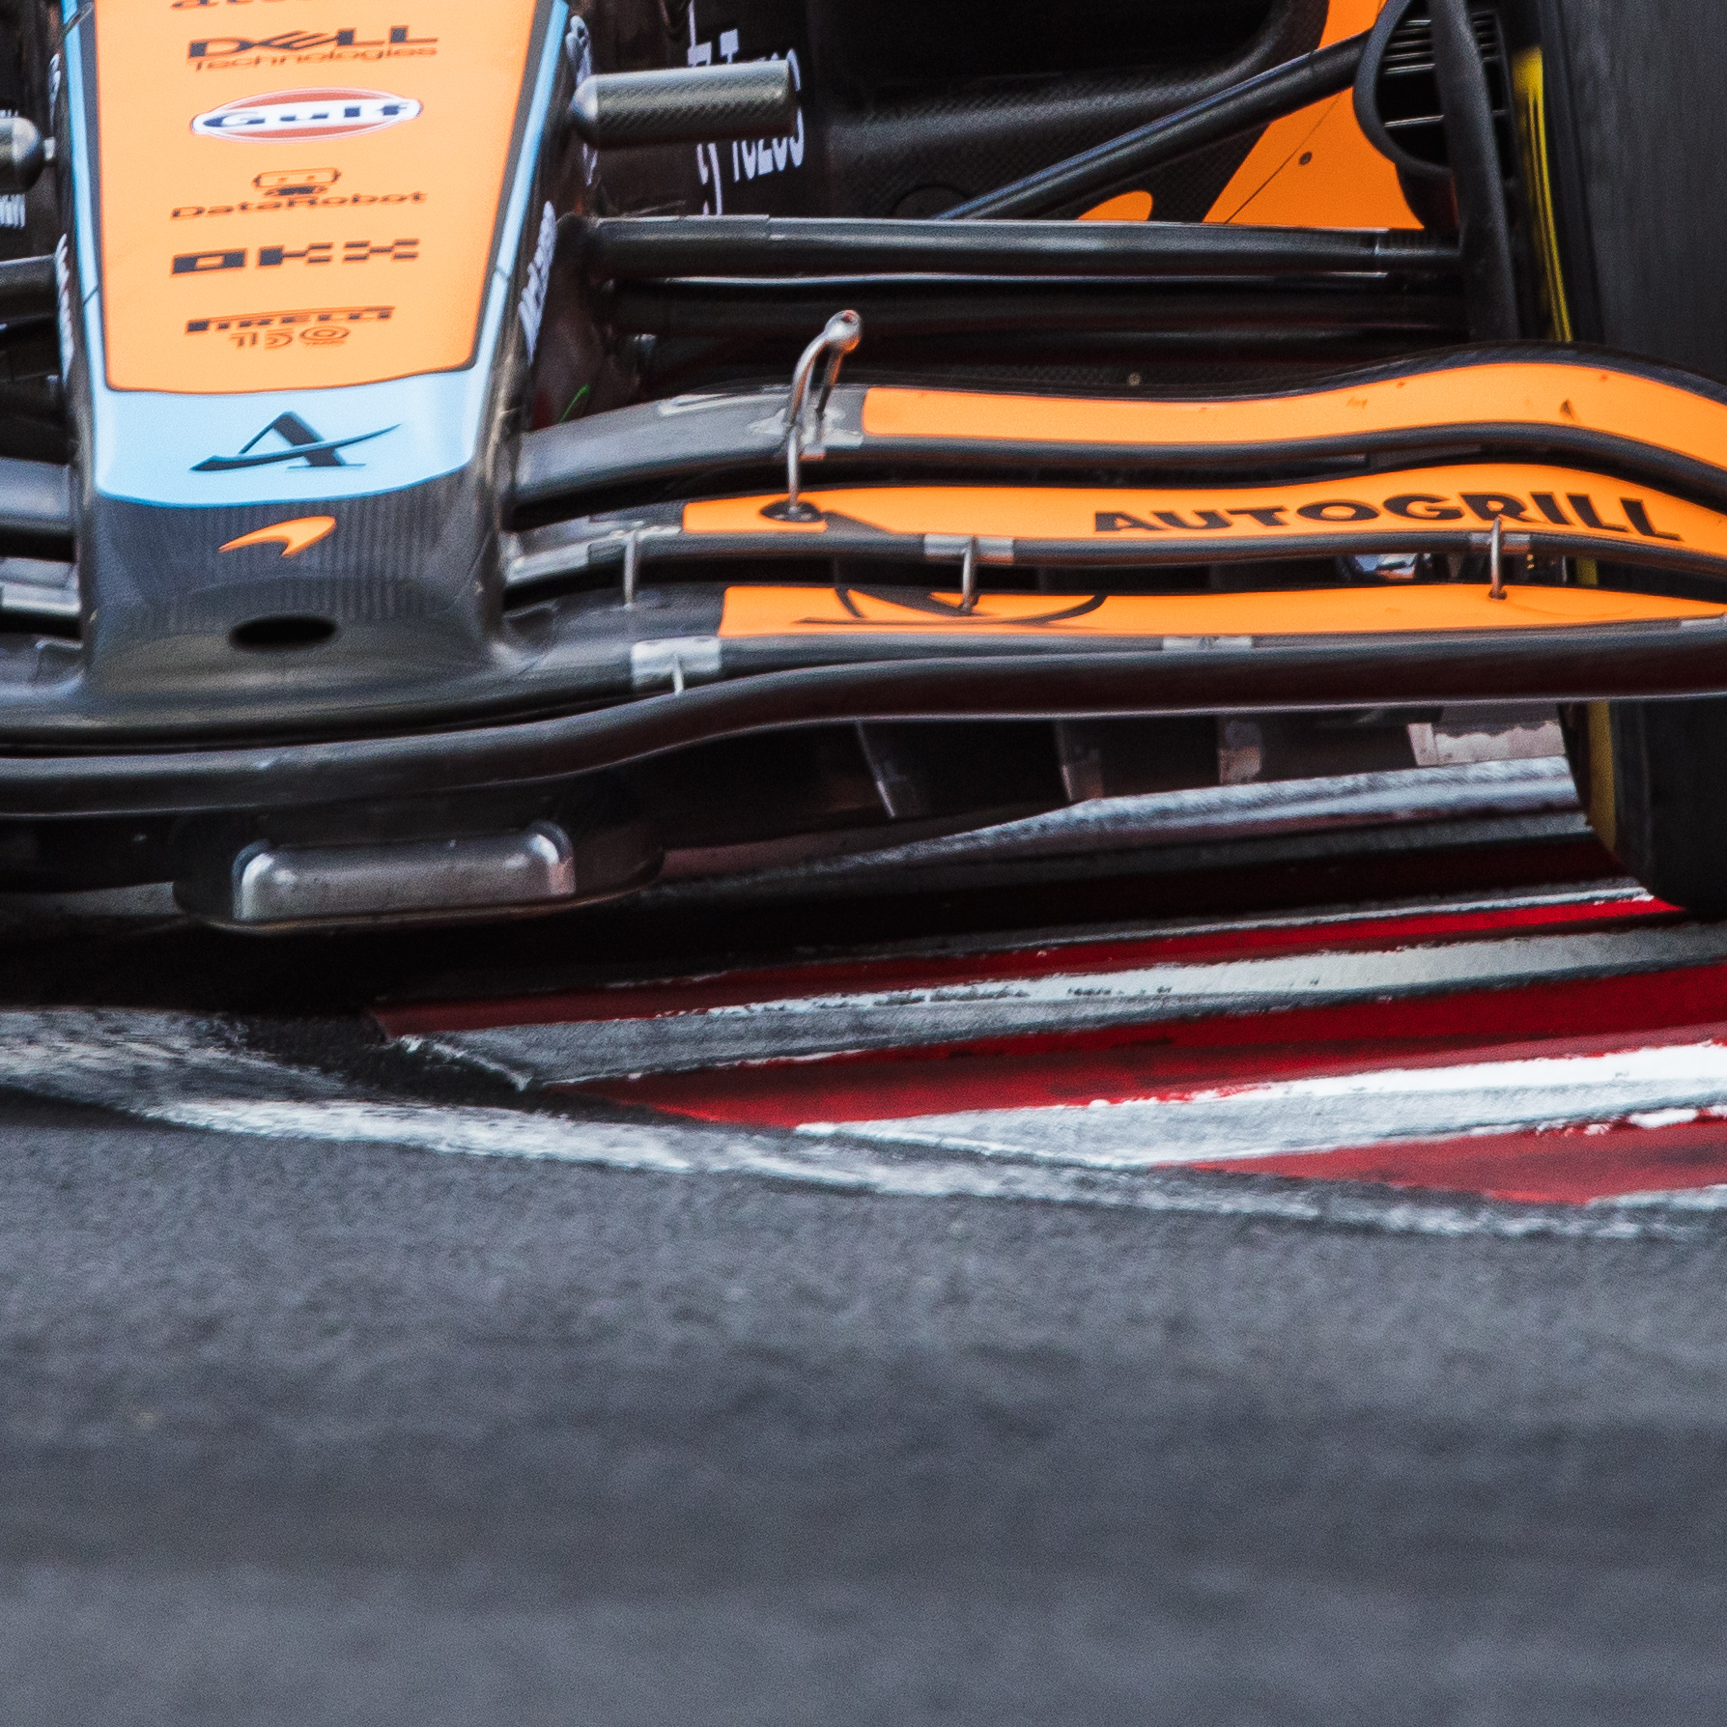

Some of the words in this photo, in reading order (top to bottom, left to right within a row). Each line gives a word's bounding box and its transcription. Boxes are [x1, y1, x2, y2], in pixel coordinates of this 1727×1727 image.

[187, 25, 439, 59] DELL
[187, 46, 439, 73] Technologies
[202, 102, 412, 129] Gulf
[170, 190, 428, 222] DataRobot
[170, 237, 421, 277] OKX
[185, 305, 396, 335] PIRELLI
[1093, 490, 1682, 543] AUTOGRILL
